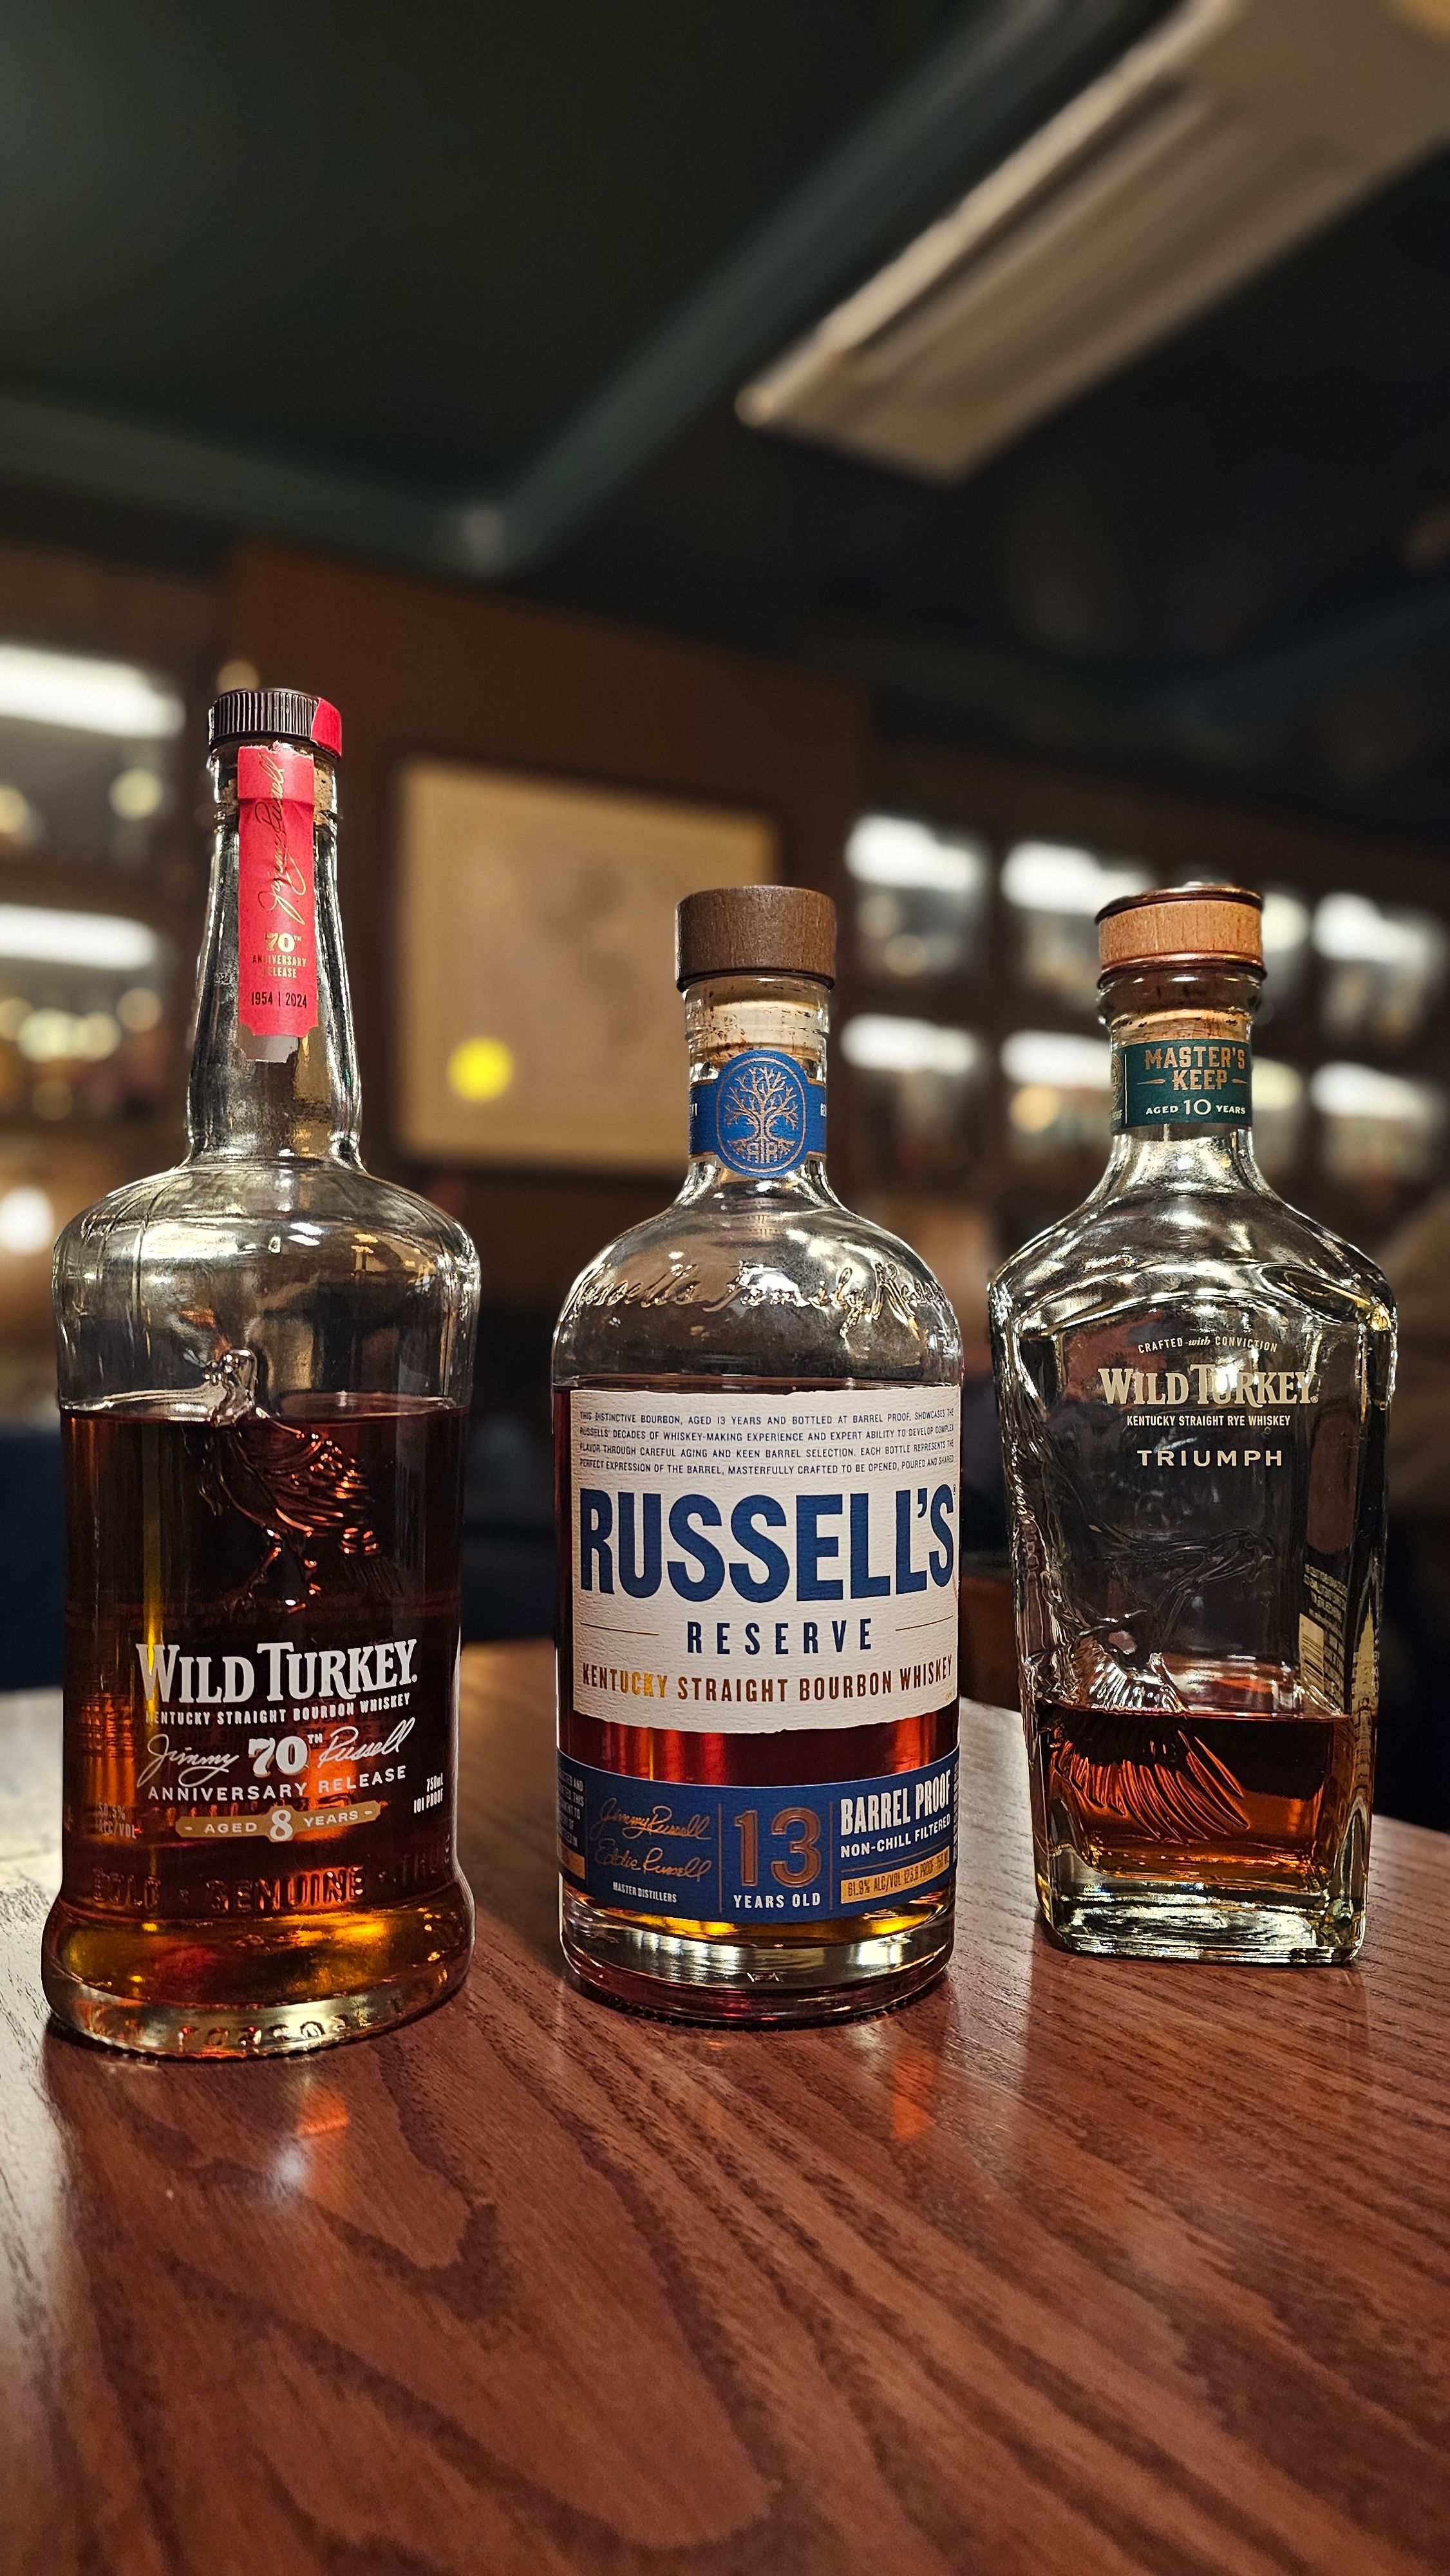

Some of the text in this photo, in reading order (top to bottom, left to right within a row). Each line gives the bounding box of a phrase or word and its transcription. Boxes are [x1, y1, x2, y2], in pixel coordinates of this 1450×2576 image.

[251, 992, 307, 1009] 1954 2024
[1145, 1046, 1245, 1070] MASTER'S
[1172, 1069, 1229, 1091] KEEP
[1145, 1099, 1246, 1115] AGED 10 YEARS
[1138, 1336, 1278, 1354] CRAFTED with CONVICTION
[1098, 1368, 1189, 1405] WILD
[579, 1412, 592, 1421] THIS
[595, 1412, 636, 1423] DISTINCTIVE
[641, 1415, 683, 1425] BOURBON,
[688, 1416, 711, 1425] AGED
[717, 1416, 726, 1425] 13
[731, 1416, 761, 1425] YEARS
[767, 1416, 786, 1425] AND
[792, 1416, 832, 1425] BOTTLED
[838, 1416, 847, 1424] AT
[852, 1414, 883, 1423] BARREL
[914, 1409, 945, 1421] SHOWCASES
[1127, 1416, 1291, 1426] KENTUCKY STRAIGHT RYE WHISKEY
[613, 1429, 645, 1439] DECADES
[650, 1431, 659, 1439] OF
[663, 1432, 742, 1441] WHISKEY-MAKING
[747, 1433, 804, 1441] EXPERIENCE
[808, 1433, 826, 1441] AND
[830, 1432, 862, 1440] EXPERT
[865, 1430, 894, 1439] ABILITY
[898, 1429, 906, 1437] TO
[909, 1426, 934, 1437] DEVELOP
[935, 1424, 954, 1434] COMPLEX
[579, 1443, 601, 1452] FLAVOR
[603, 1444, 636, 1455] THROUGH
[640, 1447, 675, 1457] CAREFUL
[681, 1449, 708, 1457] AGING
[737, 1450, 760, 1458] KEEN
[766, 1449, 801, 1457] BARREL
[805, 1448, 856, 1457] SELECTION.
[860, 1447, 881, 1455] EACH
[885, 1444, 910, 1454] BOTTLE
[914, 1441, 946, 1452] REPRESENTS
[1137, 1450, 1283, 1467] TRIUMPH
[579, 1458, 604, 1469] PERFECT
[606, 1461, 651, 1472] EXPRESSION
[654, 1464, 664, 1473] OF
[667, 1464, 683, 1473] THE
[687, 1466, 724, 1475] BARREL,
[728, 1466, 795, 1475] MASTERFULLY
[798, 1465, 838, 1473] CRAFTED
[842, 1464, 852, 1473] TO
[856, 1464, 865, 1473] BE
[869, 1462, 899, 1472] OPENED,
[901, 1459, 925, 1470] POURED
[927, 1457, 937, 1466] AND
[579, 1484, 954, 1603] RUSSELL'S
[687, 1618, 871, 1655] RESERVE
[135, 1643, 255, 1703] WILD
[582, 1654, 953, 1702] KENTUCKY STRAIGHT BOURBON WHISKEY
[146, 1692, 410, 1725] KENTUCKY STRAIGHT BOURBON WHISKEY
[317, 1716, 416, 1768] Russell
[147, 1765, 406, 1801] ANNIVERSARY RELEASE
[413, 1788, 443, 1814] 101 PROOF
[840, 1788, 911, 1835] BARREL
[915, 1769, 950, 1820] PROOF
[205, 1809, 358, 1841] AGED 8 YEARS
[840, 1814, 950, 1859] NON-CHILL FILTERED
[734, 1807, 822, 1888] 13
[206, 1866, 364, 1913] GENUINE
[613, 1881, 677, 1903] MASTER DISTILLERS
[848, 1880, 871, 1897] 61.9%
[874, 1872, 901, 1892] ALC/VOL
[733, 1892, 820, 1909] YEARS OLD
